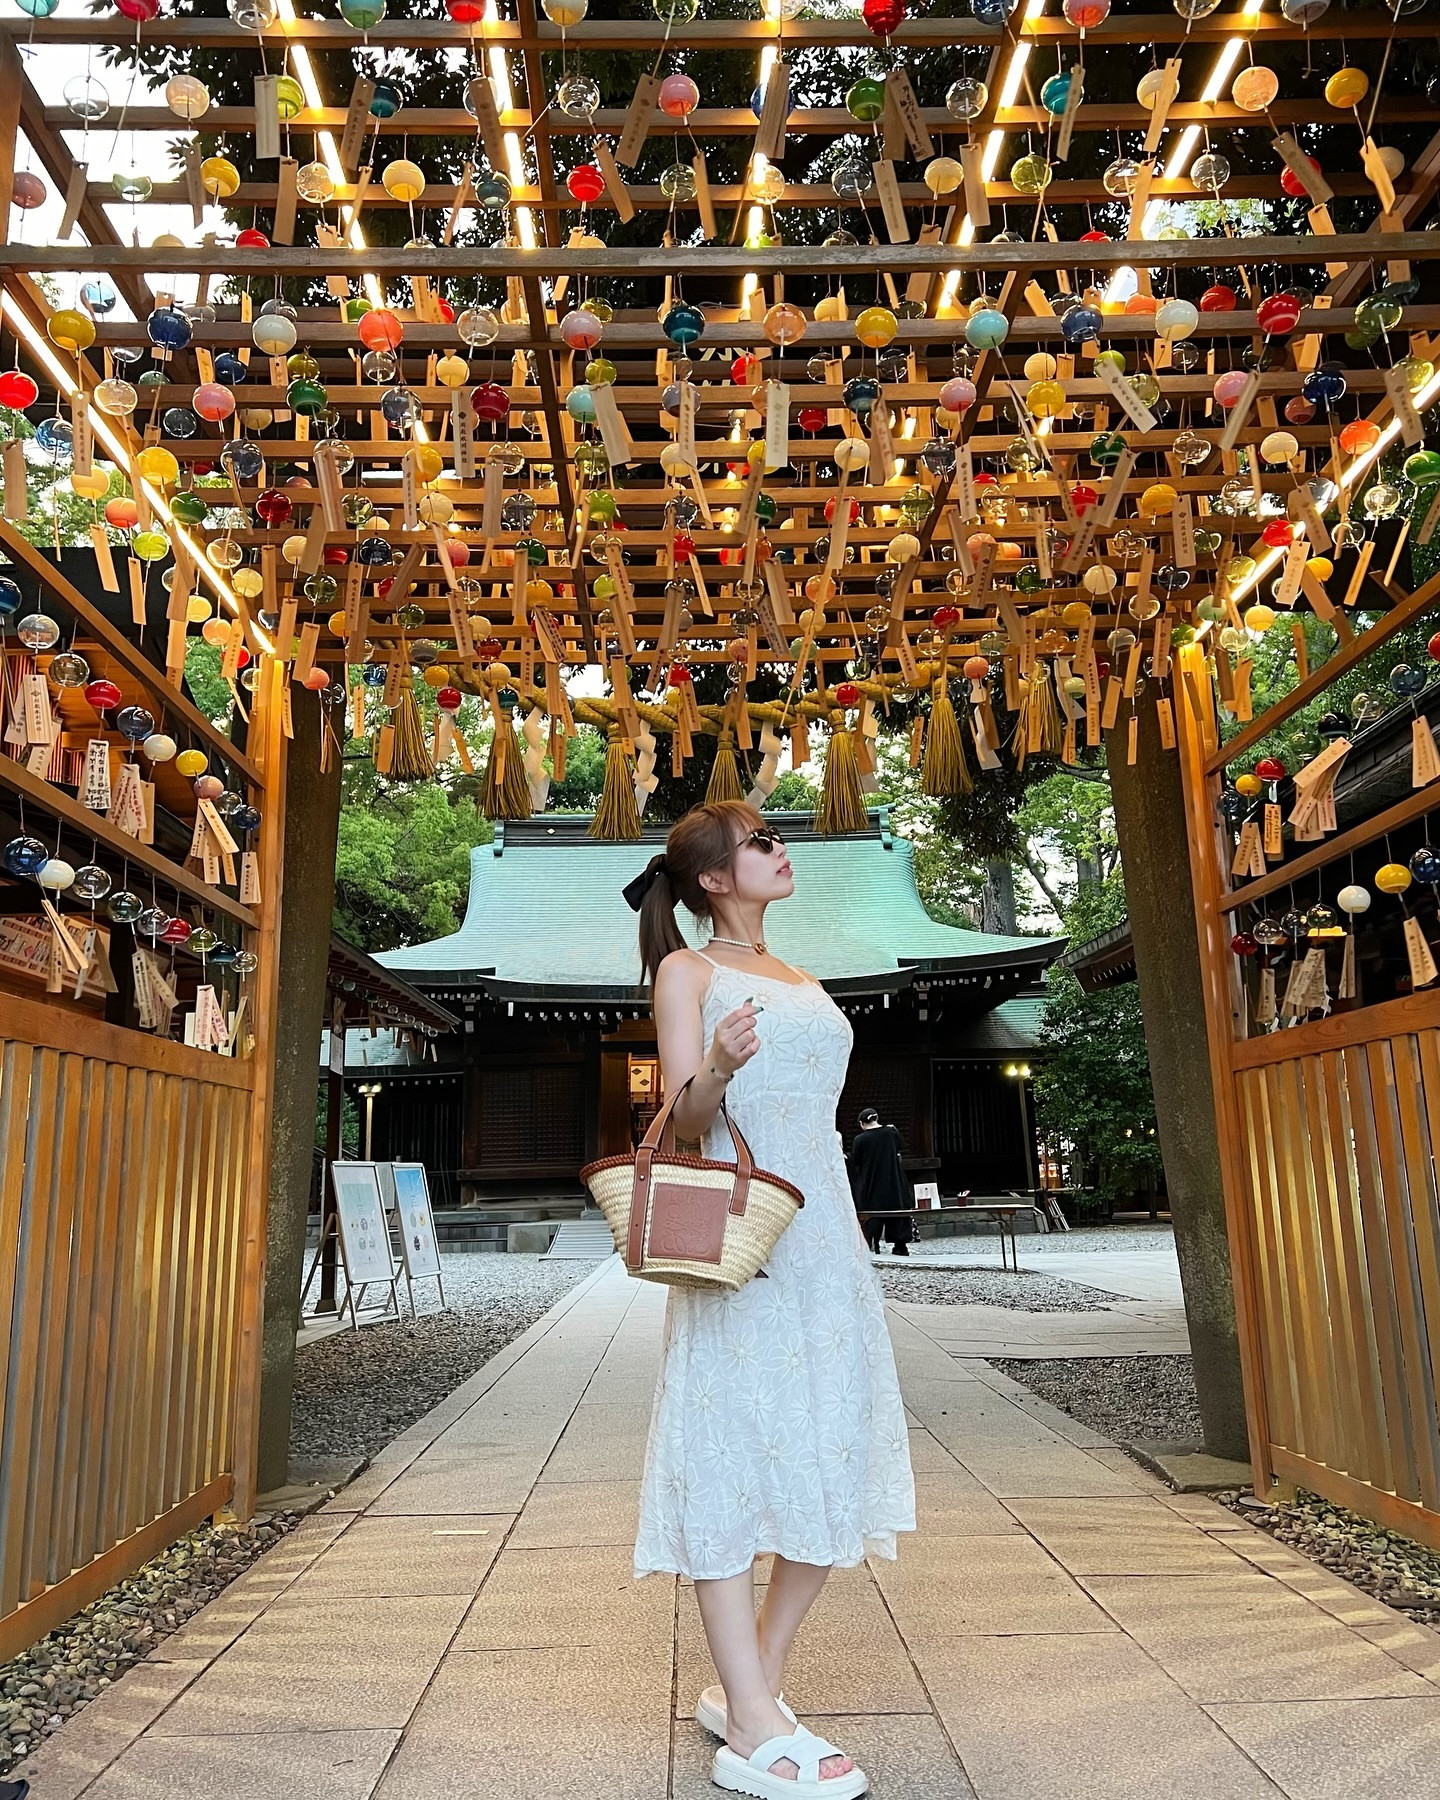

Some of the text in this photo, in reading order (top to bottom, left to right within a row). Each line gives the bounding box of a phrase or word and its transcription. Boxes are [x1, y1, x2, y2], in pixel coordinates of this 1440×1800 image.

[460, 422, 468, 463] 川越氷川神社
